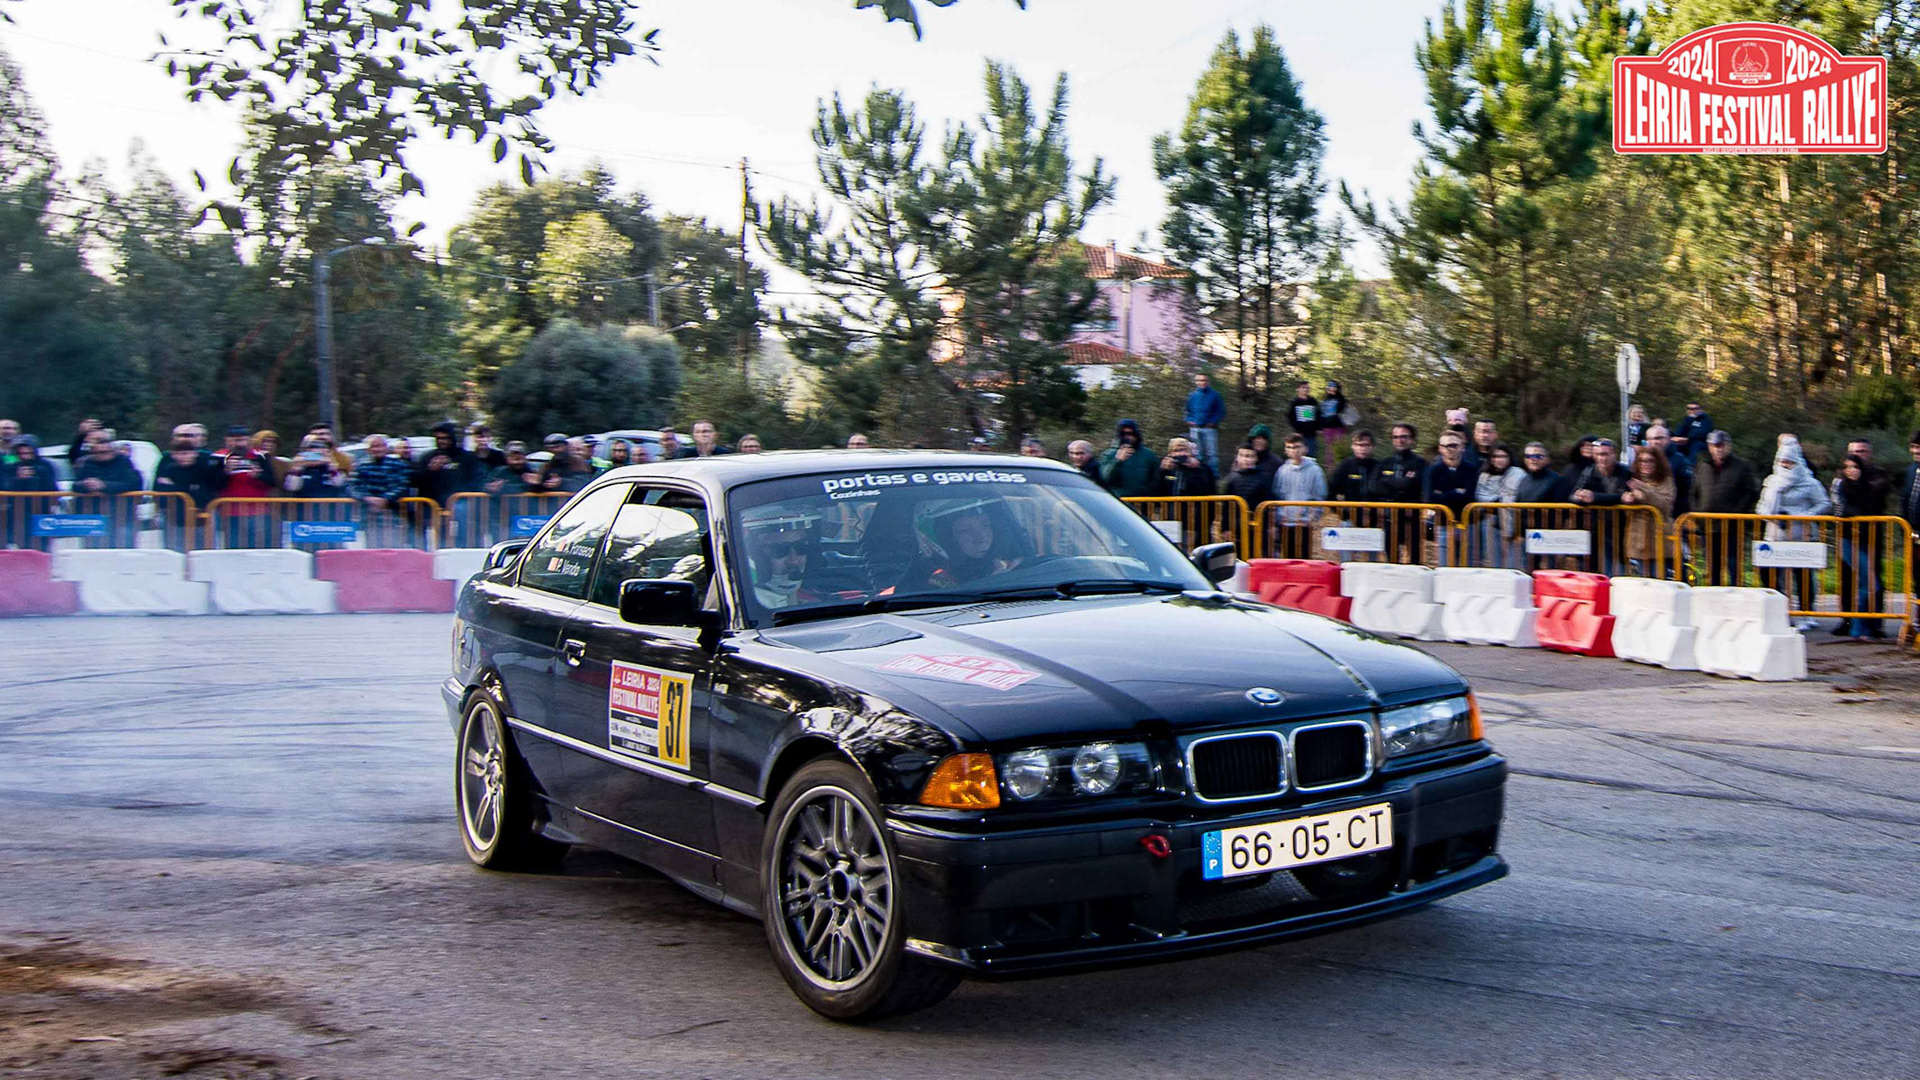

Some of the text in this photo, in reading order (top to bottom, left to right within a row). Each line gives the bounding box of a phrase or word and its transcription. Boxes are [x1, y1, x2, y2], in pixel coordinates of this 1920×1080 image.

[822, 469, 1027, 493] portas e gavetas
[829, 488, 881, 500] Cozinhas
[622, 670, 646, 690] LEIRIA
[665, 680, 684, 759] 37
[1209, 858, 1218, 870] P
